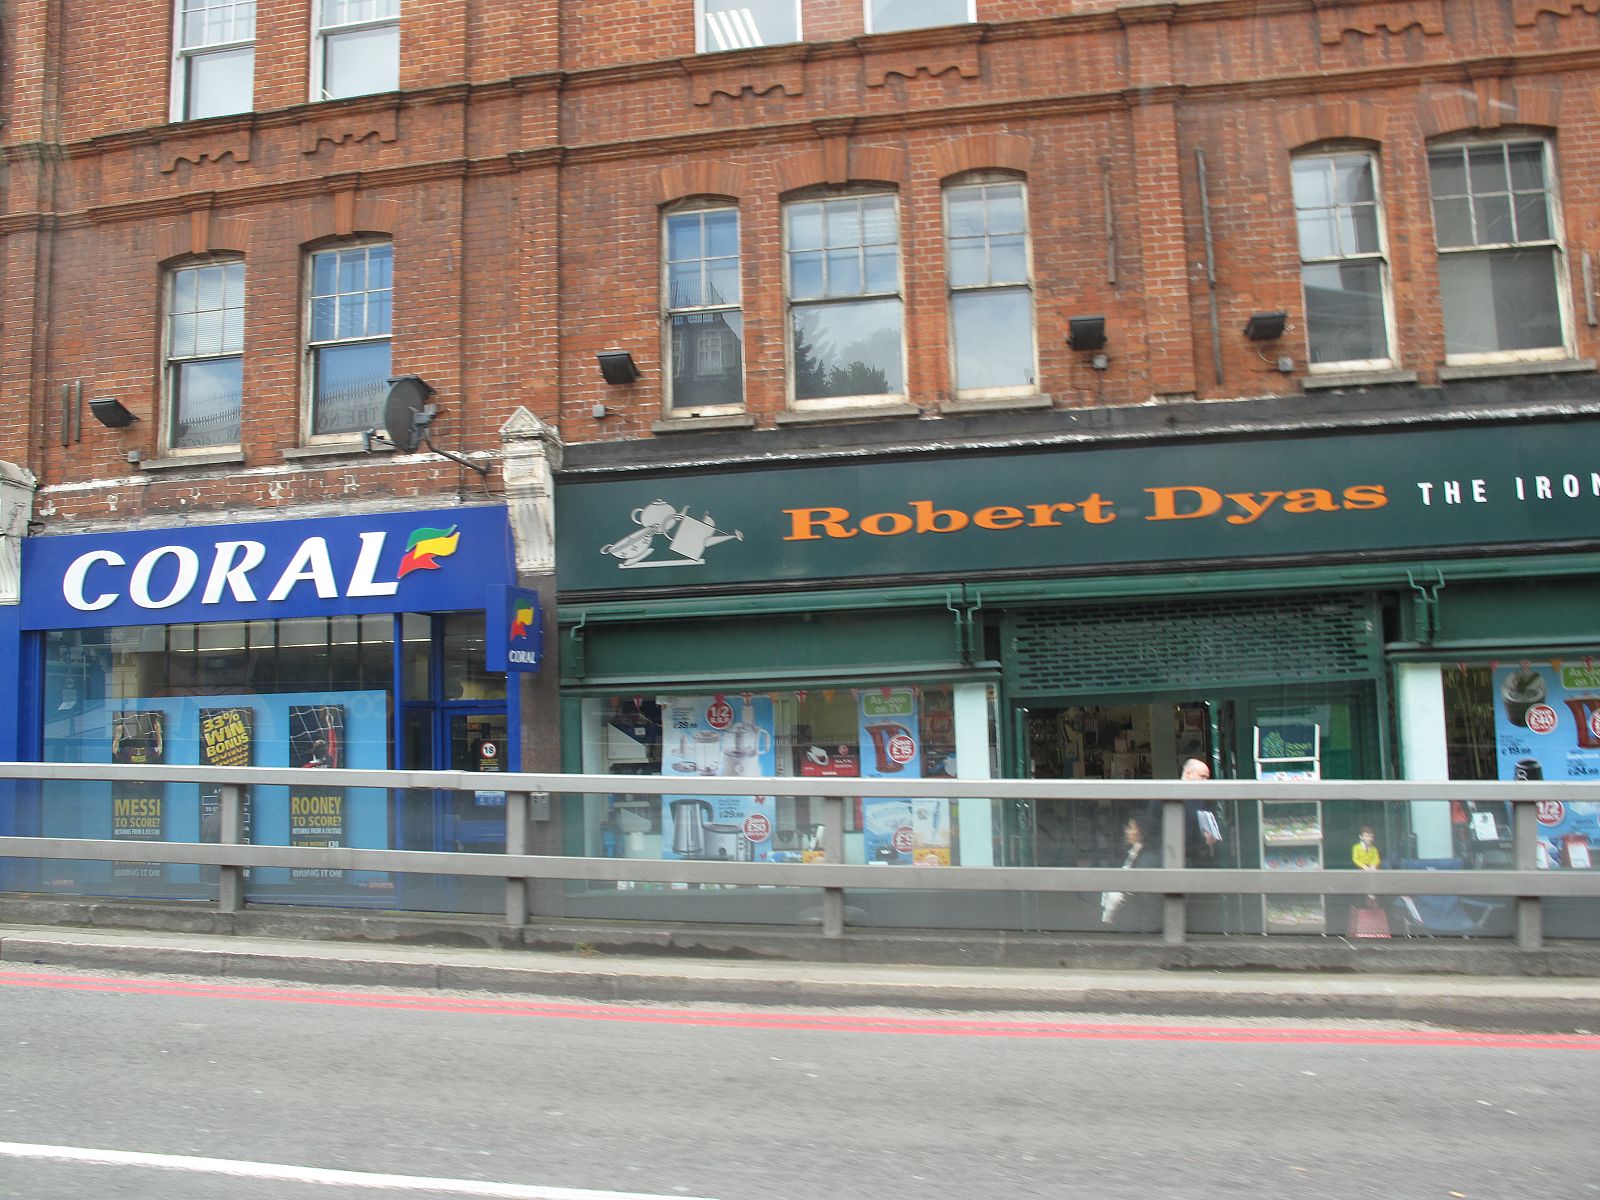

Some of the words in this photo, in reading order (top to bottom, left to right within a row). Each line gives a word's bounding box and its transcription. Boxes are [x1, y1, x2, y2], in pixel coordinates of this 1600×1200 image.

[1417, 479, 1488, 506] THE
[782, 493, 1117, 541] Robert
[1143, 484, 1389, 525] Dyas
[63, 531, 399, 611] CORAL
[508, 649, 537, 664] CORAL
[203, 709, 240, 733] 33%
[204, 721, 246, 746] WIN
[206, 733, 250, 758] BONUS
[114, 799, 160, 816] MESSI
[291, 797, 342, 815] ROONEY
[115, 818, 128, 828] TO
[130, 817, 160, 828] SCORE?
[292, 817, 306, 827] TO
[308, 816, 342, 827] SCORE?
